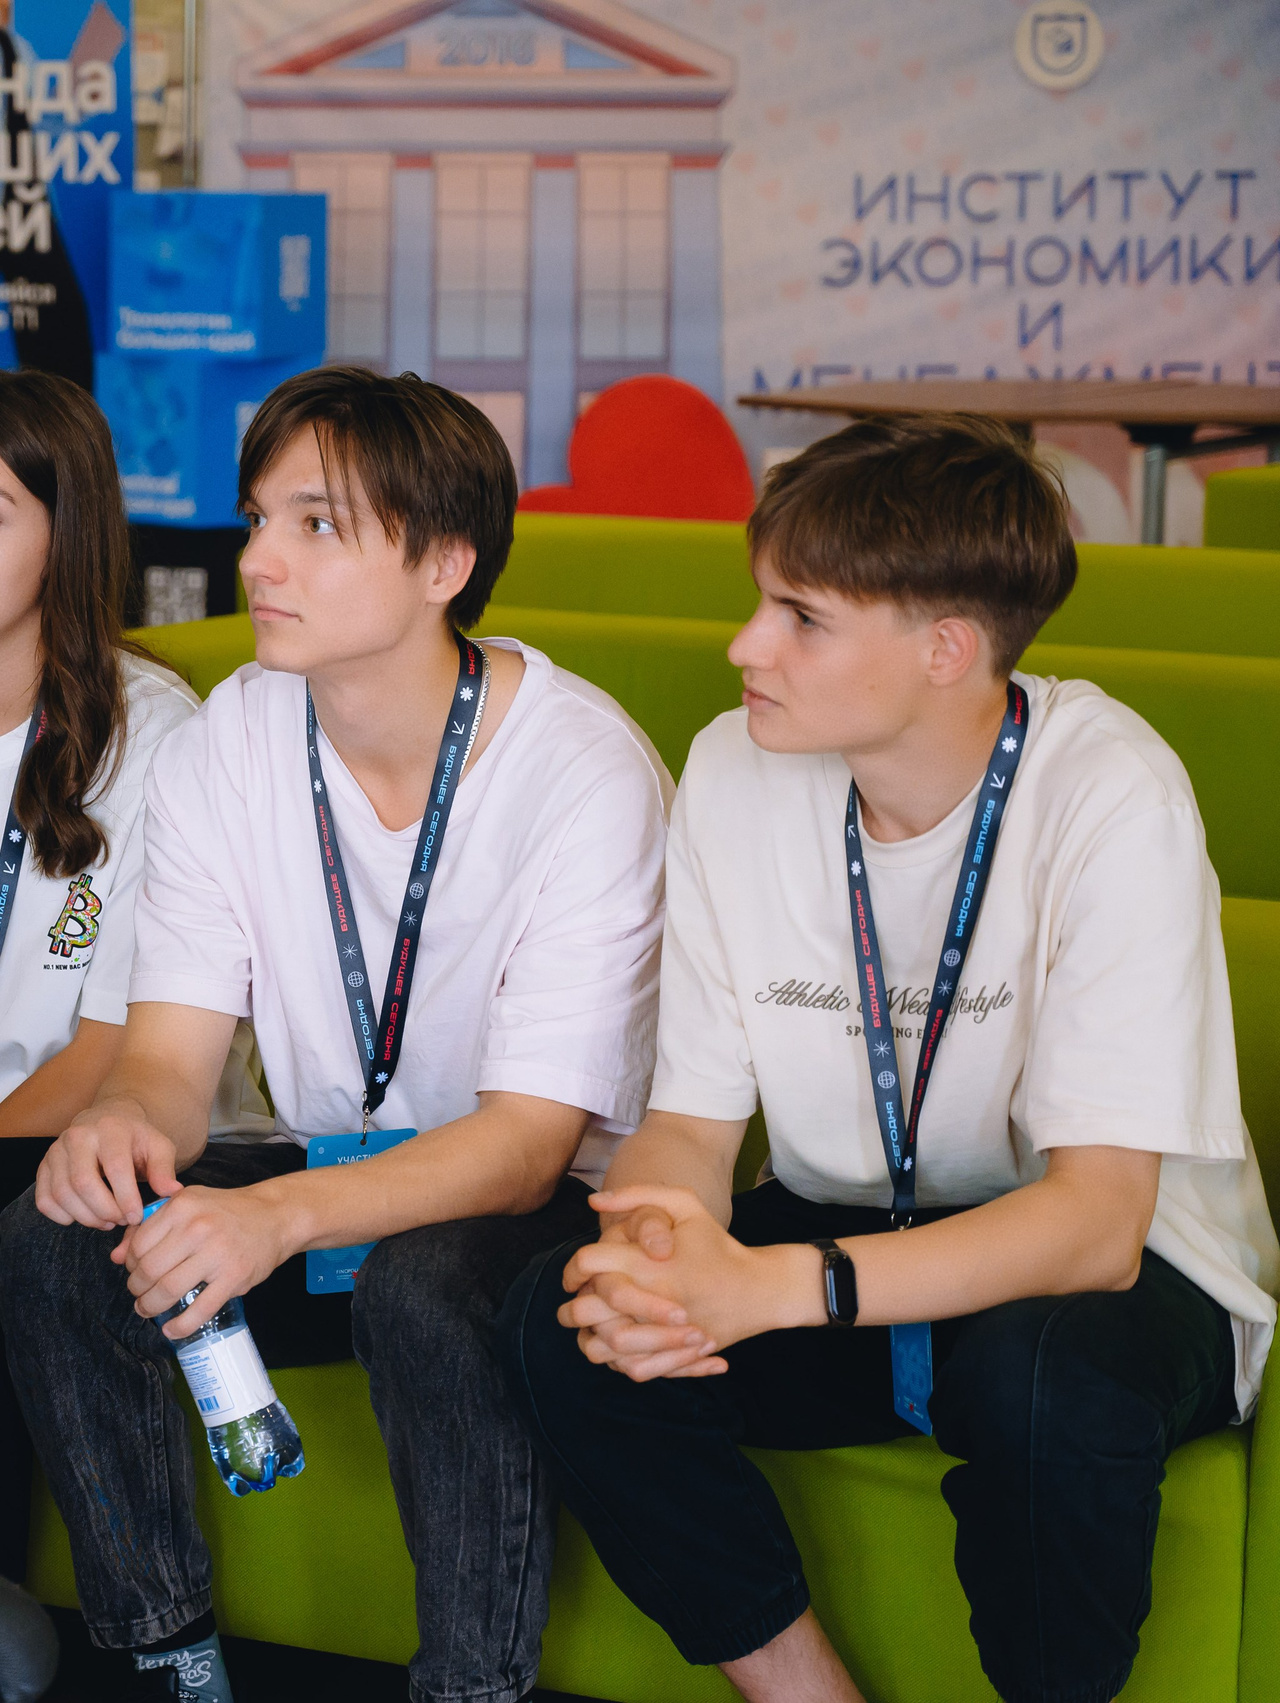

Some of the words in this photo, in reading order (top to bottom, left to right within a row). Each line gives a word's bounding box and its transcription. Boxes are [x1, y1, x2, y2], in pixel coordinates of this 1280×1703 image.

[852, 169, 1257, 224] ИНСТИТУТ
[820, 233, 1280, 289] ЭКОНОМИКИ
[1019, 300, 1063, 351] И
[436, 745, 457, 805] БУДУЩЕЕ
[420, 811, 440, 872] СЕГОДНЯ
[973, 799, 996, 864] БУДУЩЕЕ
[331, 873, 348, 932] БУДУЩЕЕ
[855, 889, 871, 957] СЕГОДНЯ
[955, 870, 978, 937] СЕГОДНЯ
[393, 938, 411, 996] БУДУЩЕЕ
[866, 963, 882, 1028] БУДУЩЕЕ
[754, 979, 851, 1012] Athletic
[886, 986, 932, 1016] Wea
[356, 998, 375, 1061] СЕГОДНЯ
[383, 1002, 399, 1061] СЕГОДНЯ
[885, 1101, 902, 1169] СЕГОДНЯ
